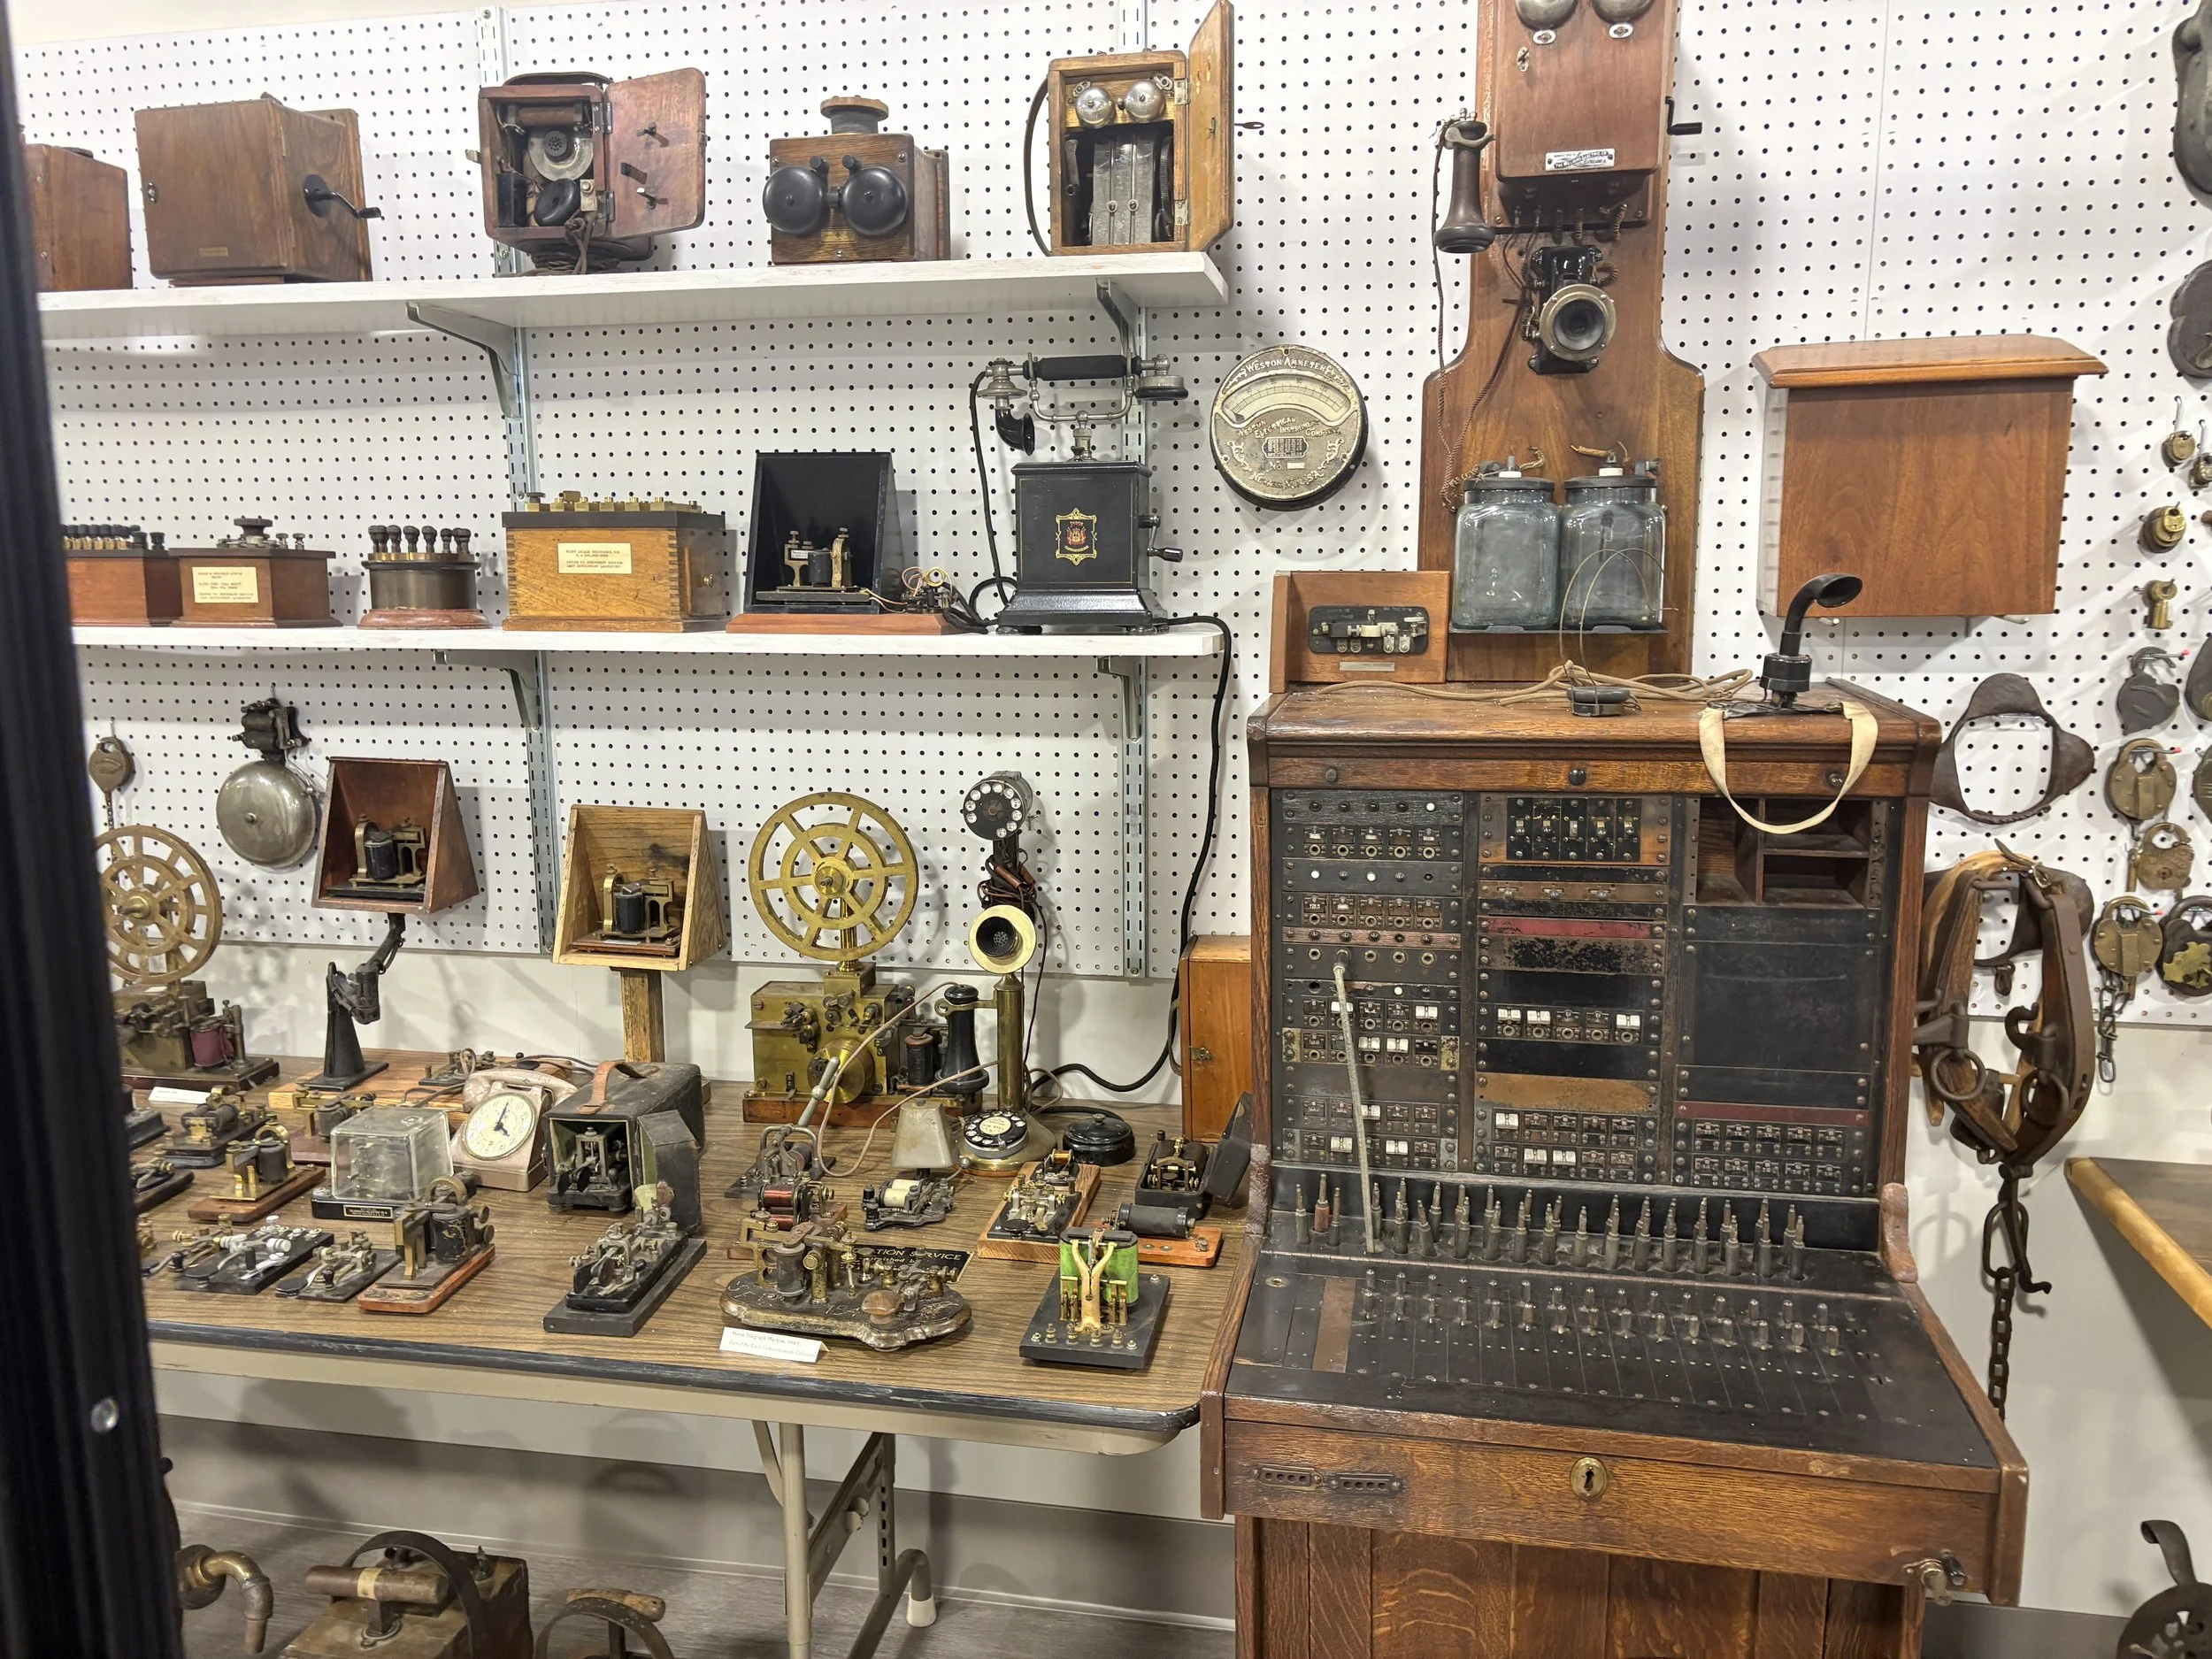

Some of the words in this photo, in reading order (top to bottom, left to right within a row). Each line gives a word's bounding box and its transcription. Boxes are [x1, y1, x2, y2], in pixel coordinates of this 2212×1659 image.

[1246, 358, 1282, 373] WESTON
[1284, 357, 1327, 372] AMMETER
[910, 1250, 962, 1261] SRVICE
